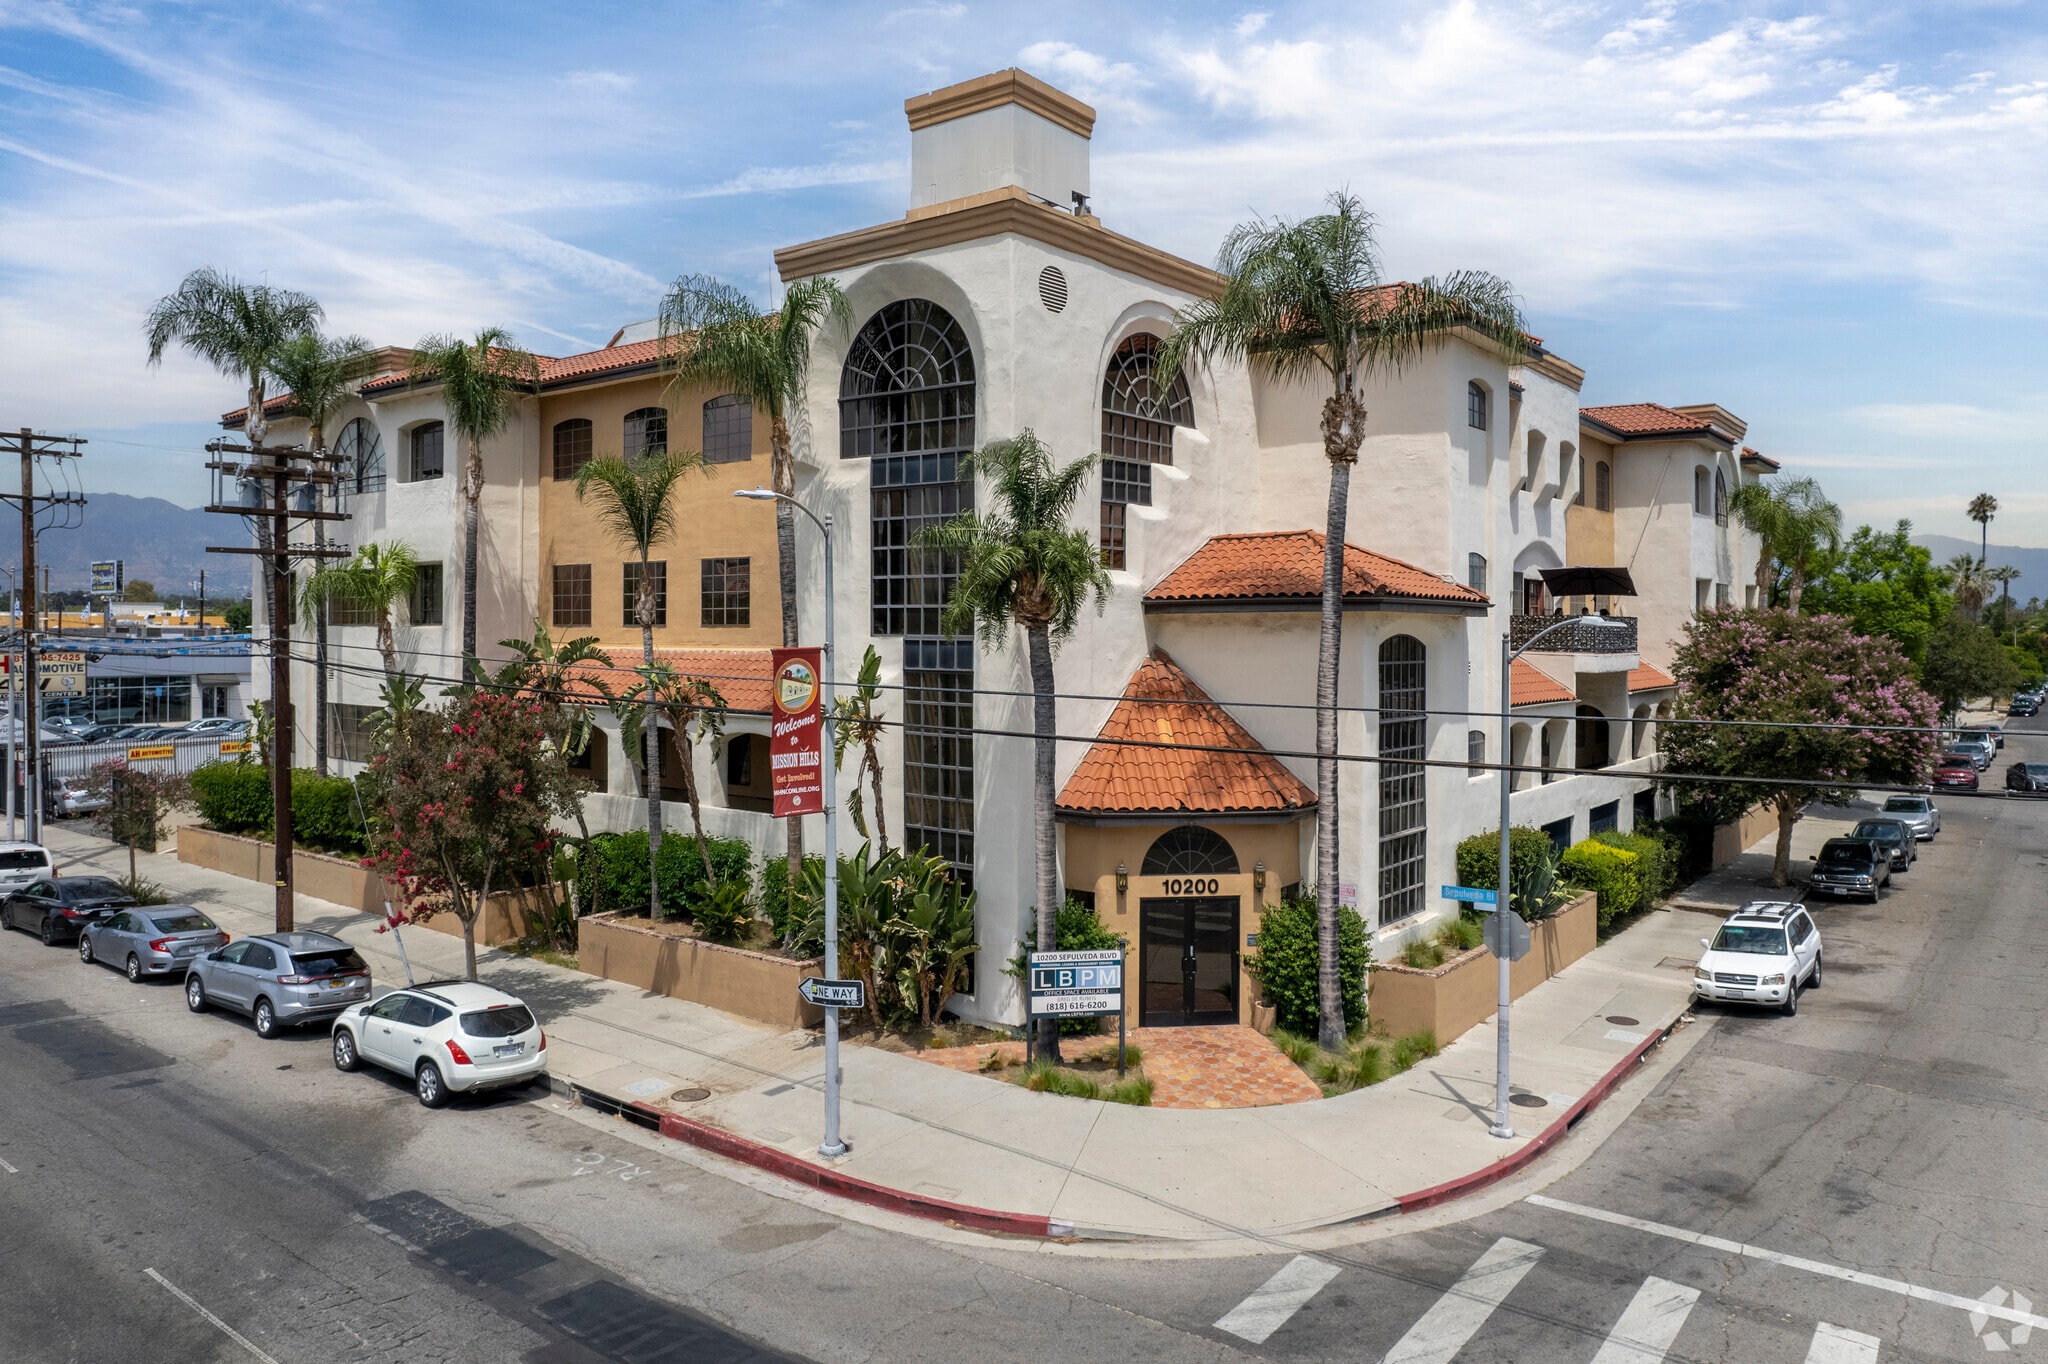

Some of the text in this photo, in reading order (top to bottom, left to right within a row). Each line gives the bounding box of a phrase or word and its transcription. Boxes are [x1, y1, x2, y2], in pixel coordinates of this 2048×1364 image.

[774, 714, 816, 737] Welcome
[790, 736, 799, 746] to
[130, 749, 141, 758] AH
[772, 752, 819, 769] MISSION HILLS
[776, 772, 815, 783] Get Involved!
[774, 786, 820, 795] MHNCONLINE.ORG
[1162, 878, 1219, 895] 10200
[1445, 888, 1484, 900] Sepulveda
[1036, 952, 1117, 962] 10200 SEPULVEDA BLVD
[832, 988, 854, 999] WAY
[1081, 988, 1109, 996] AVAILABLE
[1046, 1001, 1107, 1012] (818) 616-6200
